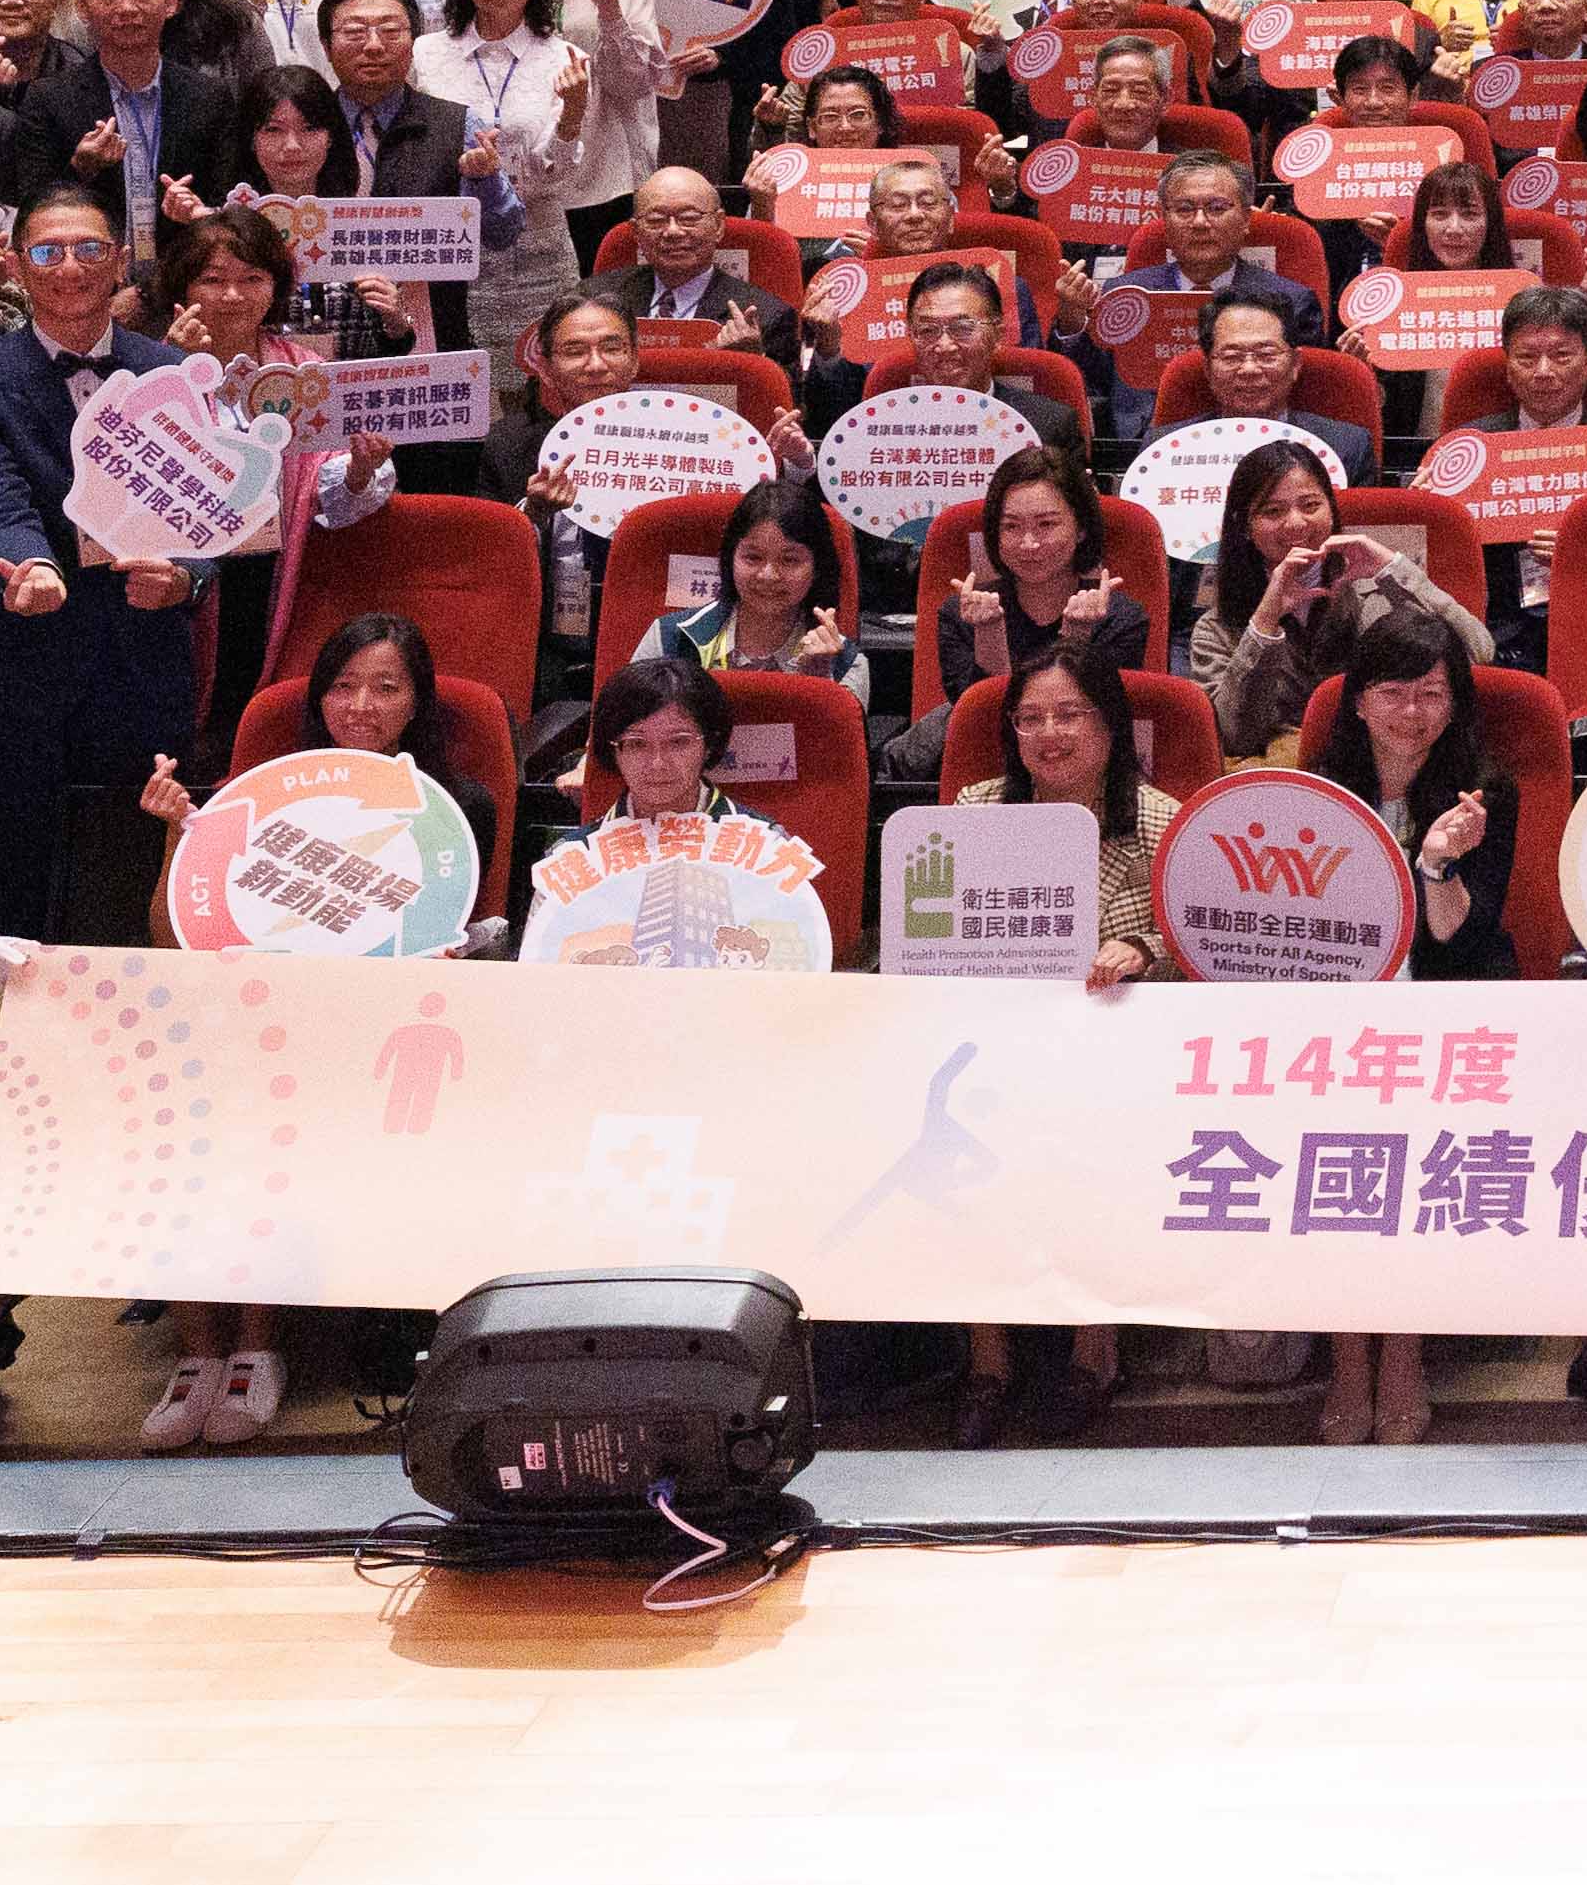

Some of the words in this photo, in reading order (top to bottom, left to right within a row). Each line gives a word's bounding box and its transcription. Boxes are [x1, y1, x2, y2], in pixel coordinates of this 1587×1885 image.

[331, 228, 473, 246] 長庚醫療財團法人
[330, 248, 474, 267] 高雄長庚紀念醫院
[341, 381, 472, 410] 宏碁資訊服務
[93, 403, 245, 538] 迪芬尼聲學科技
[584, 447, 734, 477] 日月光半導體製造
[868, 448, 996, 465] 台灣美光記憶體
[283, 766, 350, 792] PLAN
[252, 819, 423, 913] 健康職場
[538, 818, 820, 905] 健康勞動力
[193, 874, 213, 918] ACT
[233, 858, 369, 935] 新動能
[961, 886, 1075, 911] 衛生福利部
[961, 915, 1075, 940] 國民健康署
[1183, 904, 1382, 949] 運動部全民運動署
[1199, 938, 1251, 957] Sports
[1255, 943, 1276, 958] for
[1280, 946, 1300, 961] All
[1304, 949, 1365, 972] Agency,
[1174, 1026, 1519, 1106] 114年度
